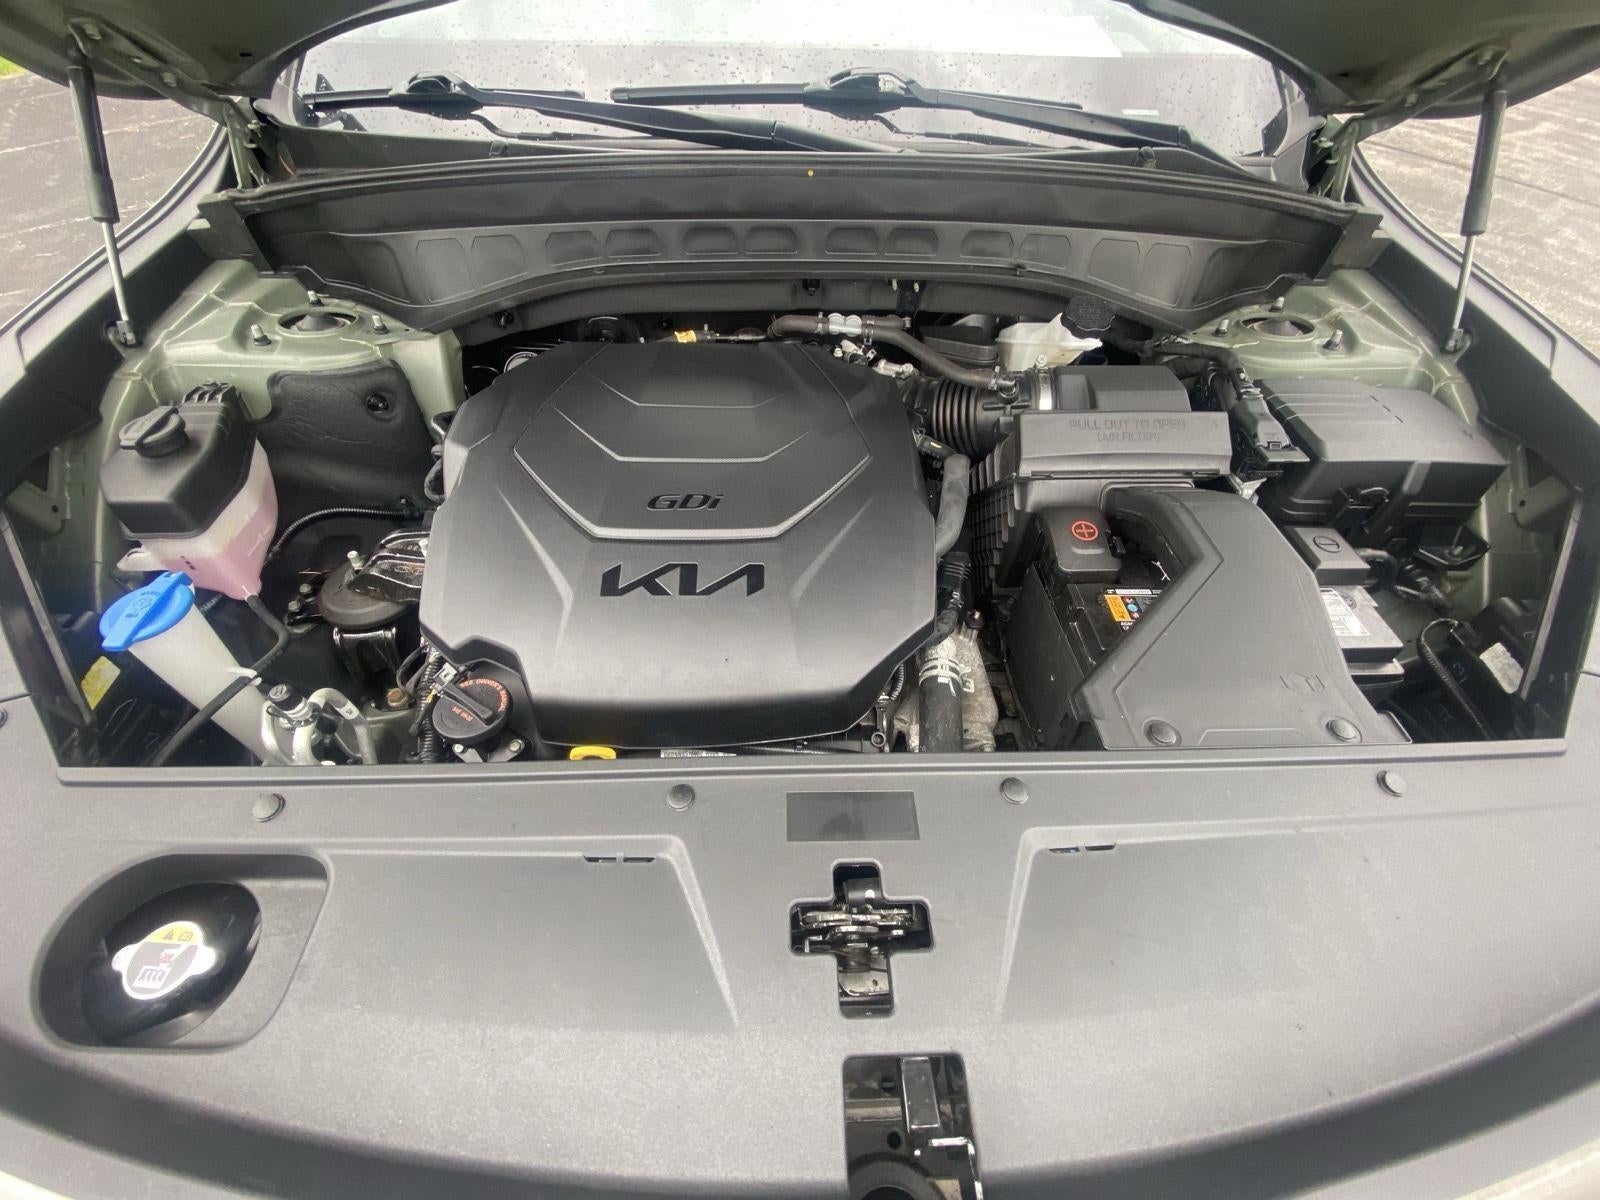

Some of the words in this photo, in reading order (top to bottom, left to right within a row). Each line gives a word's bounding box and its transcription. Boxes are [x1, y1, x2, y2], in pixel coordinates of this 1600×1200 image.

[1104, 419, 1129, 431] OUT
[1135, 419, 1150, 431] TO
[647, 493, 725, 511] GDi
[600, 561, 765, 597] KIA
